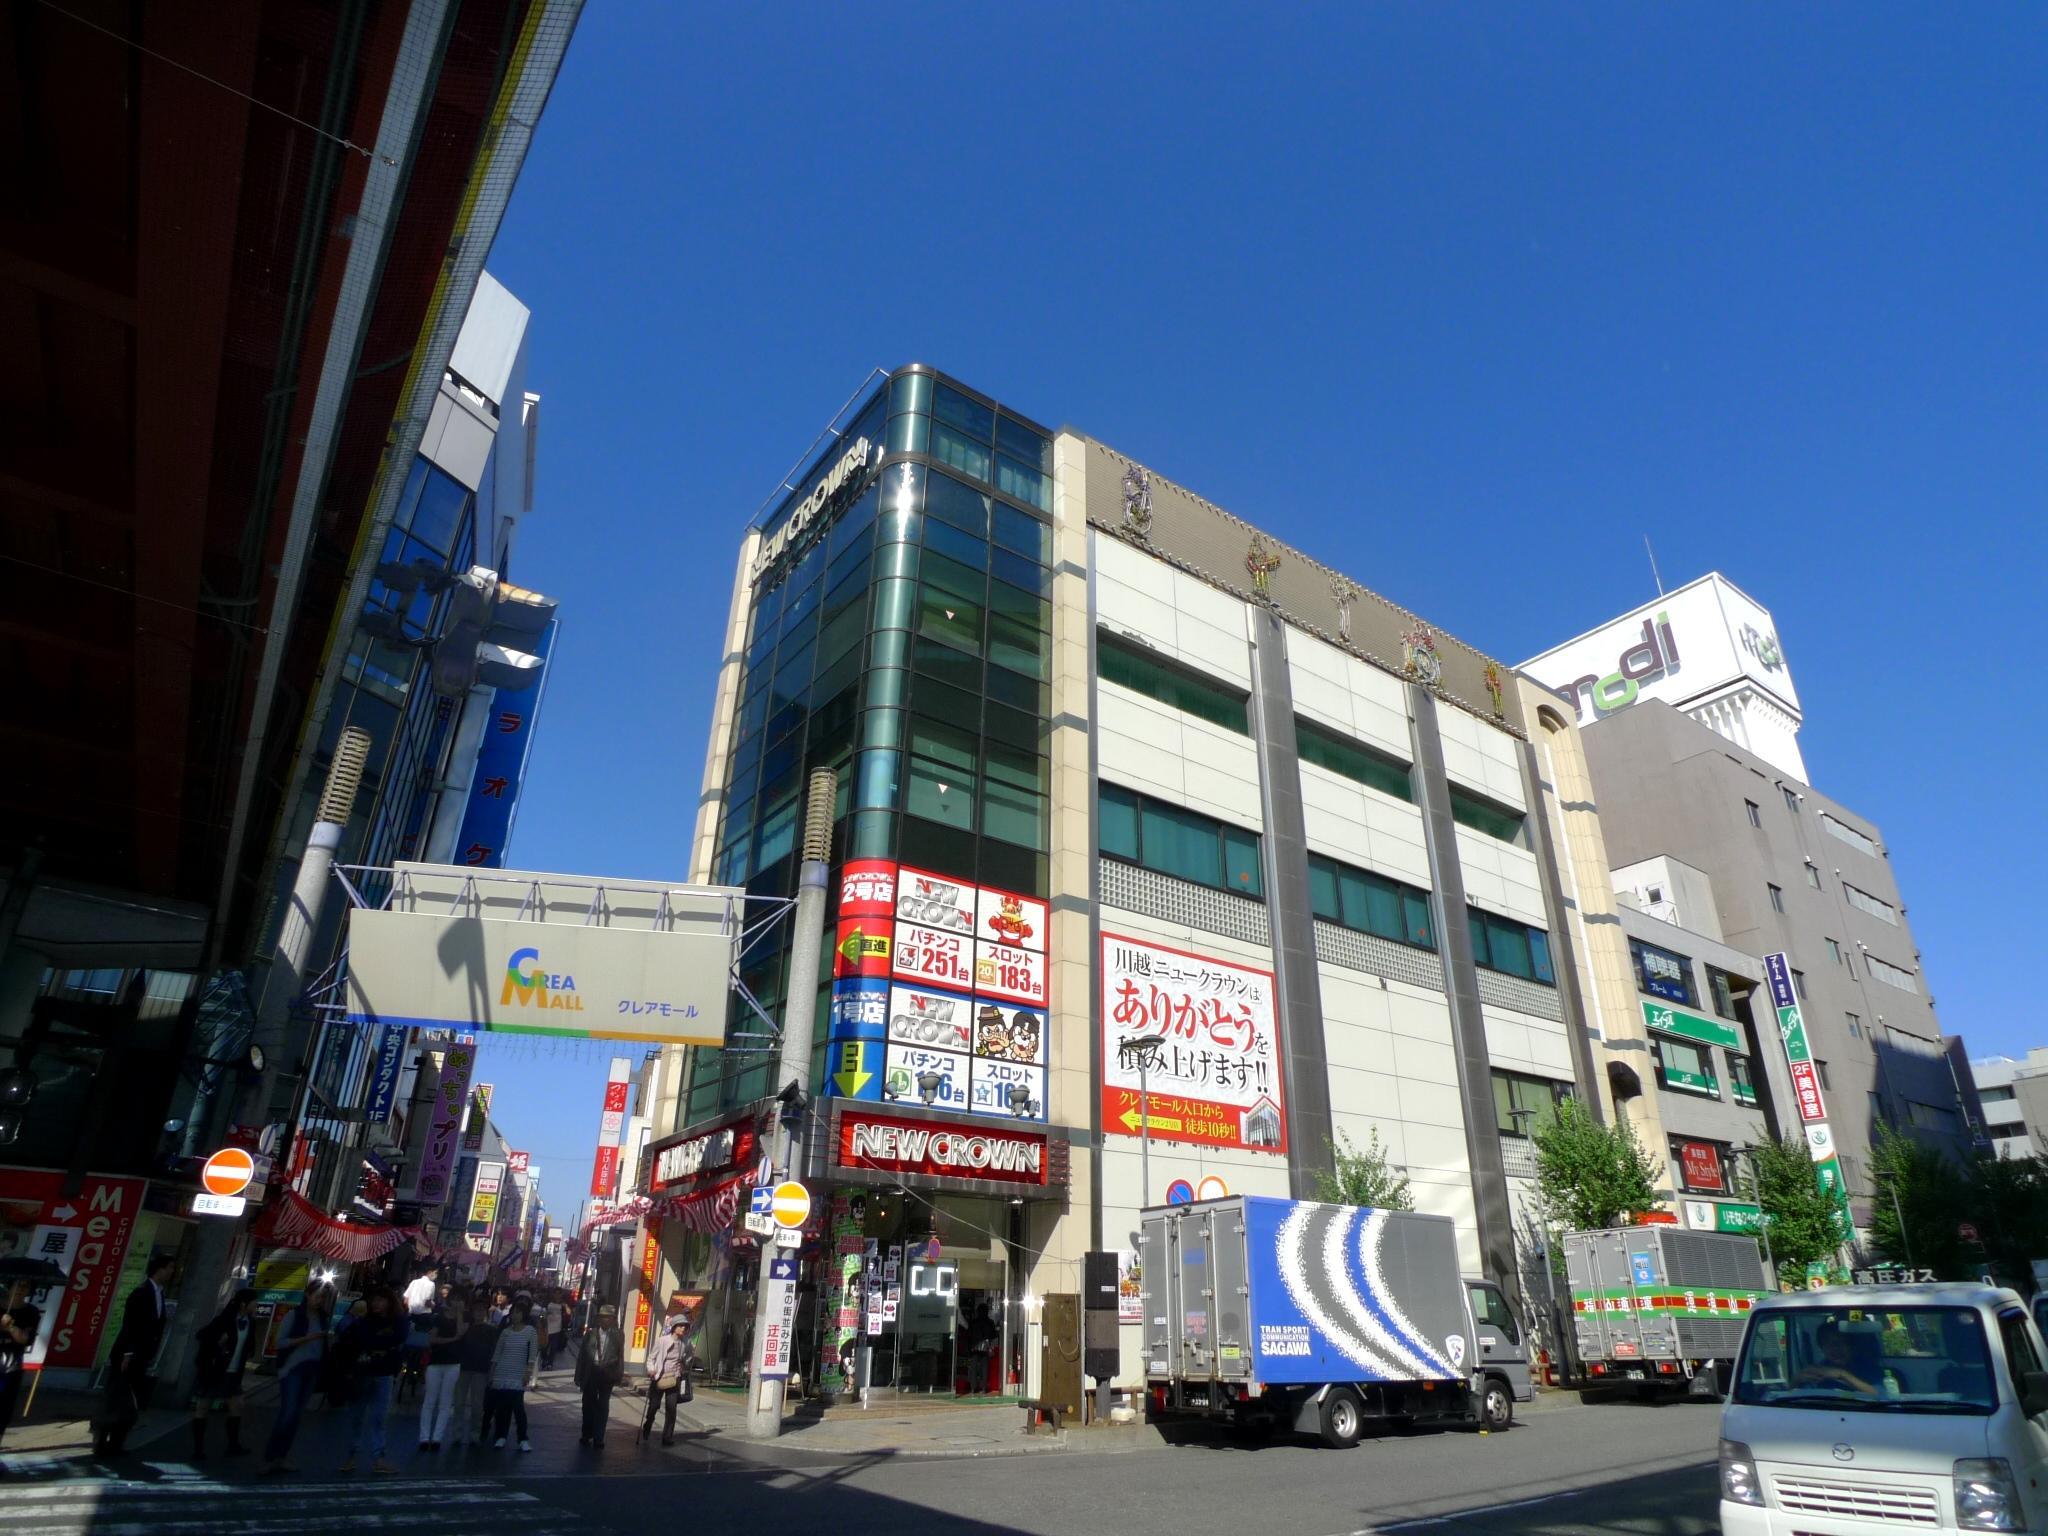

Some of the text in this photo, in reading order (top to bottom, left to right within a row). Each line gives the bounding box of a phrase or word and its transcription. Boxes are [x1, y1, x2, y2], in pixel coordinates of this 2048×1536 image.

[842, 882, 894, 903] 2号店
[916, 877, 959, 905] NEW
[898, 895, 973, 932] CROWN
[861, 937, 887, 953] 直進
[910, 929, 960, 951] パチンコ
[921, 948, 969, 981] 251台
[989, 946, 1033, 966] スロット
[500, 970, 584, 1011] MALL
[998, 964, 1042, 995] 183台
[617, 999, 699, 1019] クレアモール
[834, 1001, 886, 1024] 1号店
[910, 994, 955, 1021] NEW
[890, 1014, 969, 1048] CROWN
[903, 1050, 955, 1072] パチンコ
[1794, 1064, 1811, 1075] 2F
[987, 1063, 1033, 1083] スロット
[433, 1048, 469, 1160] めっちゃプリ
[1798, 1076, 1820, 1118] 美容室
[368, 1110, 386, 1121] 1F
[852, 1123, 1040, 1174] NEW CROWN
[1855, 1268, 1938, 1285] 高圧ガス
[779, 1283, 795, 1364] 蔵の街並み方面
[764, 1324, 780, 1367] 迂回路
[1261, 1341, 1311, 1356] SAGAWA
[1262, 1333, 1309, 1341] COMMUNICATION
